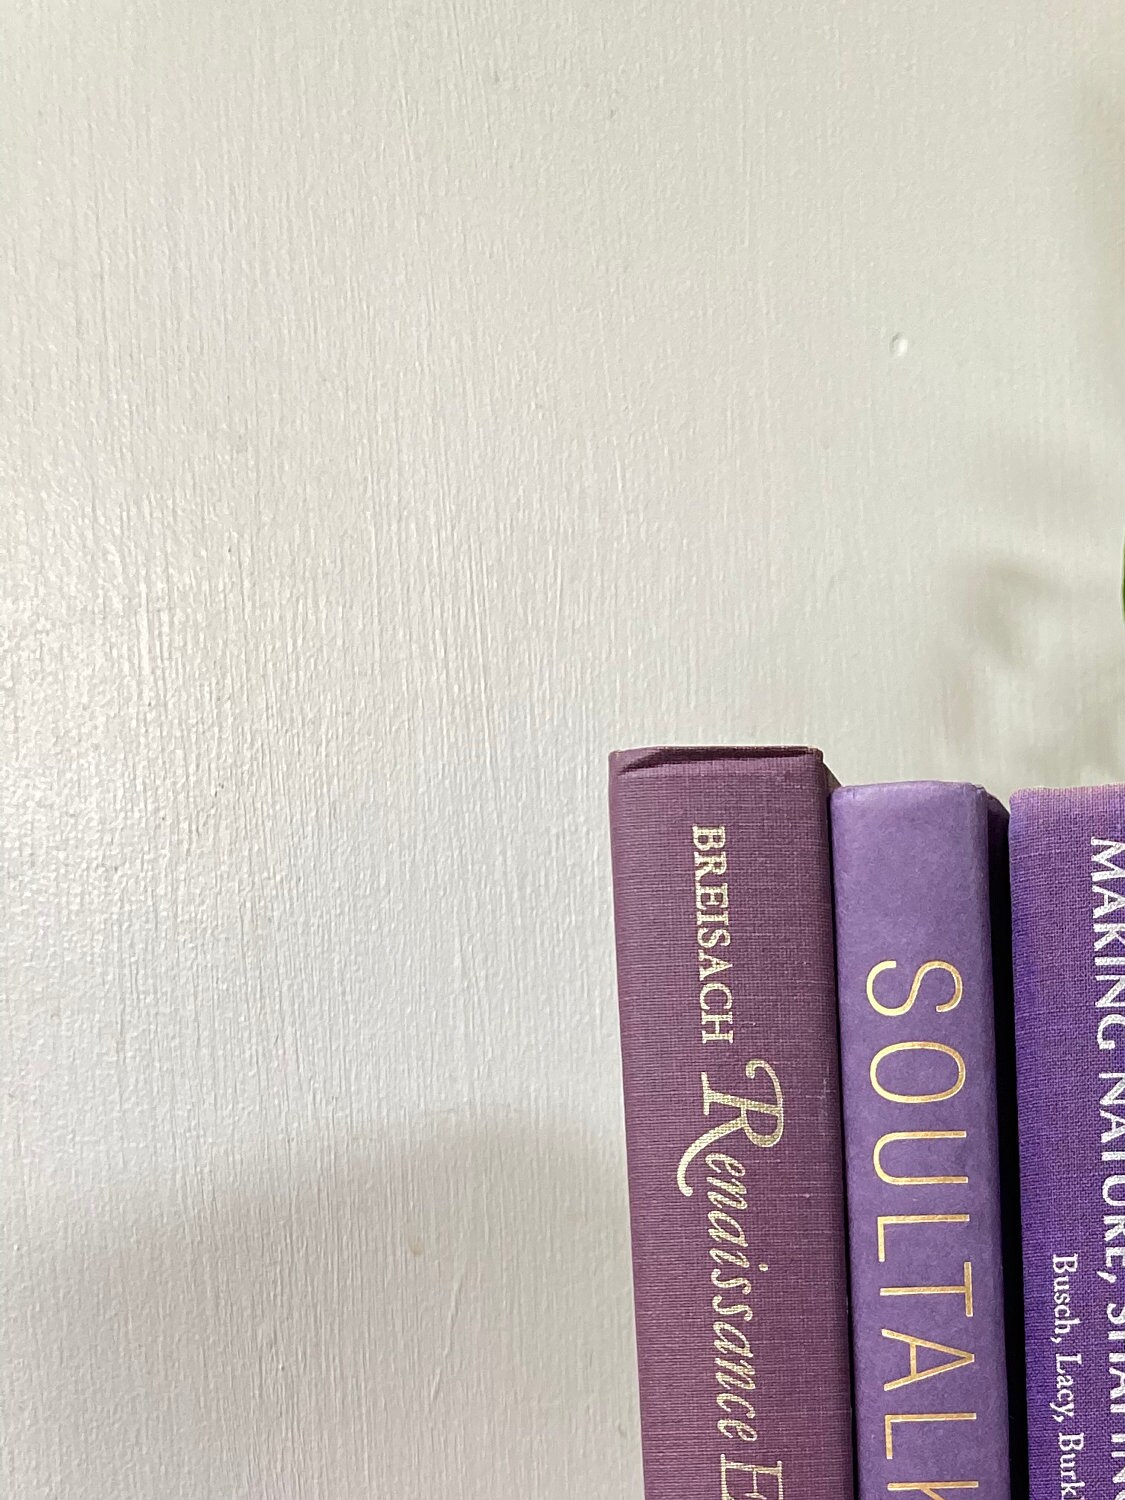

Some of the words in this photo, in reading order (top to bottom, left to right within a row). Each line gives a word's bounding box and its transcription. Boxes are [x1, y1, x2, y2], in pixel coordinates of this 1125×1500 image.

[691, 824, 734, 1045] BREISACH
[677, 1058, 784, 1443] Renaissance
[1050, 1252, 1081, 1344] Busch,
[1049, 1352, 1082, 1423] Lacy,
